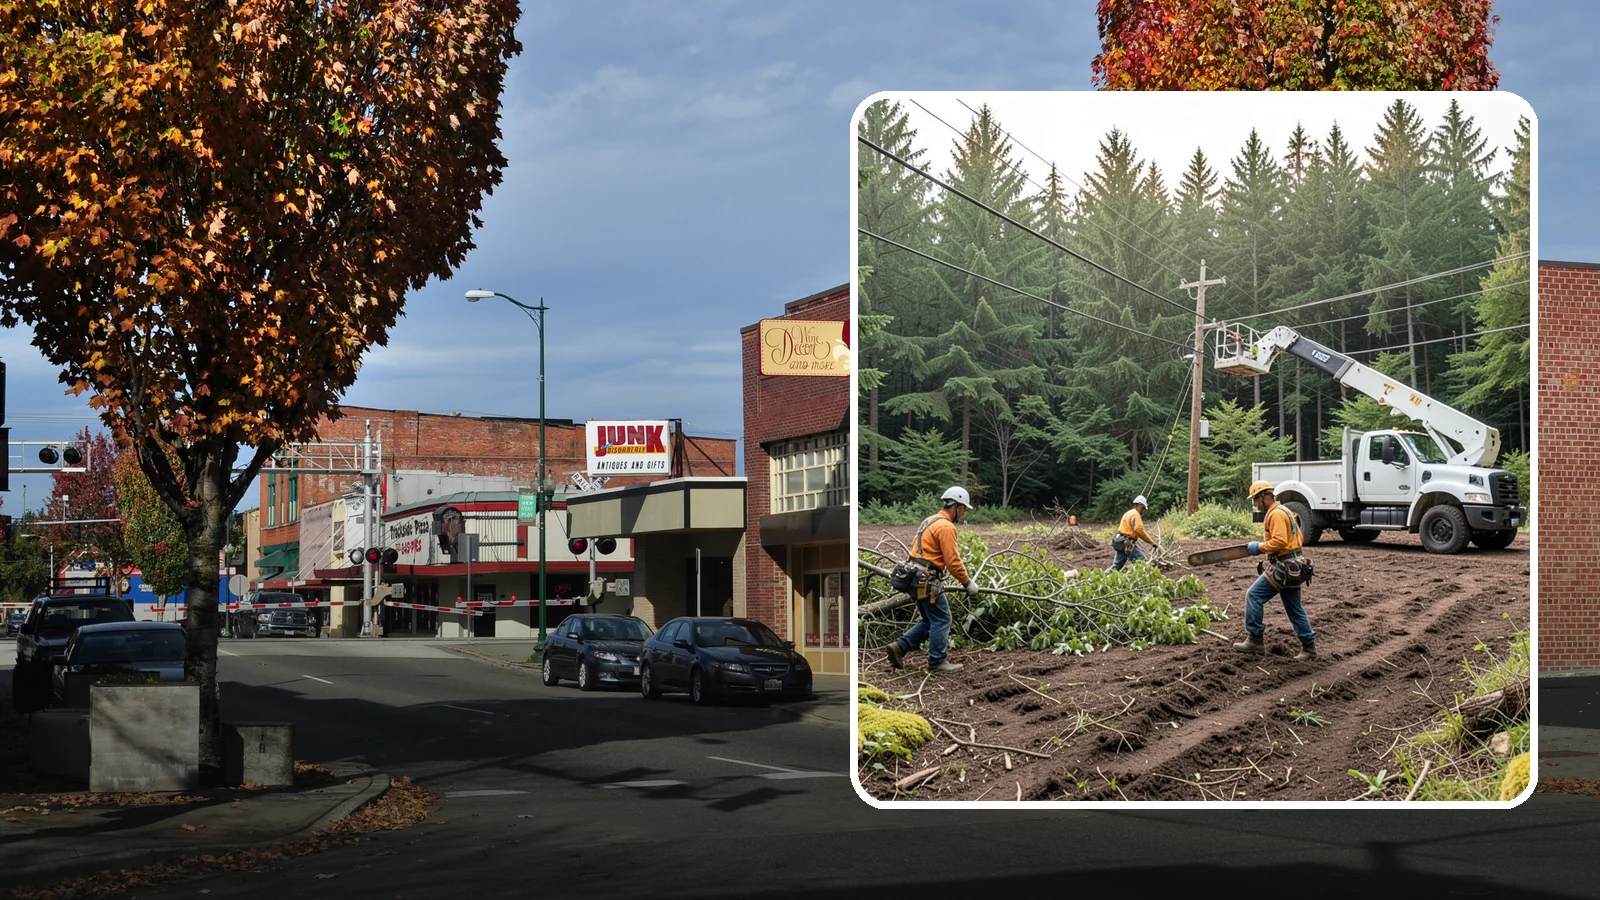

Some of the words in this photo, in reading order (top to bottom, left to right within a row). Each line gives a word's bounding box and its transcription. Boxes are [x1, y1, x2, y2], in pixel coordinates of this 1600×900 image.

[595, 425, 665, 457] JUNK
[607, 446, 646, 454] DISORDERLY
[597, 461, 628, 470] ANTIQUES
[631, 461, 644, 470] AND
[647, 460, 665, 470] GIFTS
[390, 521, 413, 540] Trackside
[414, 519, 429, 535] Pizza
